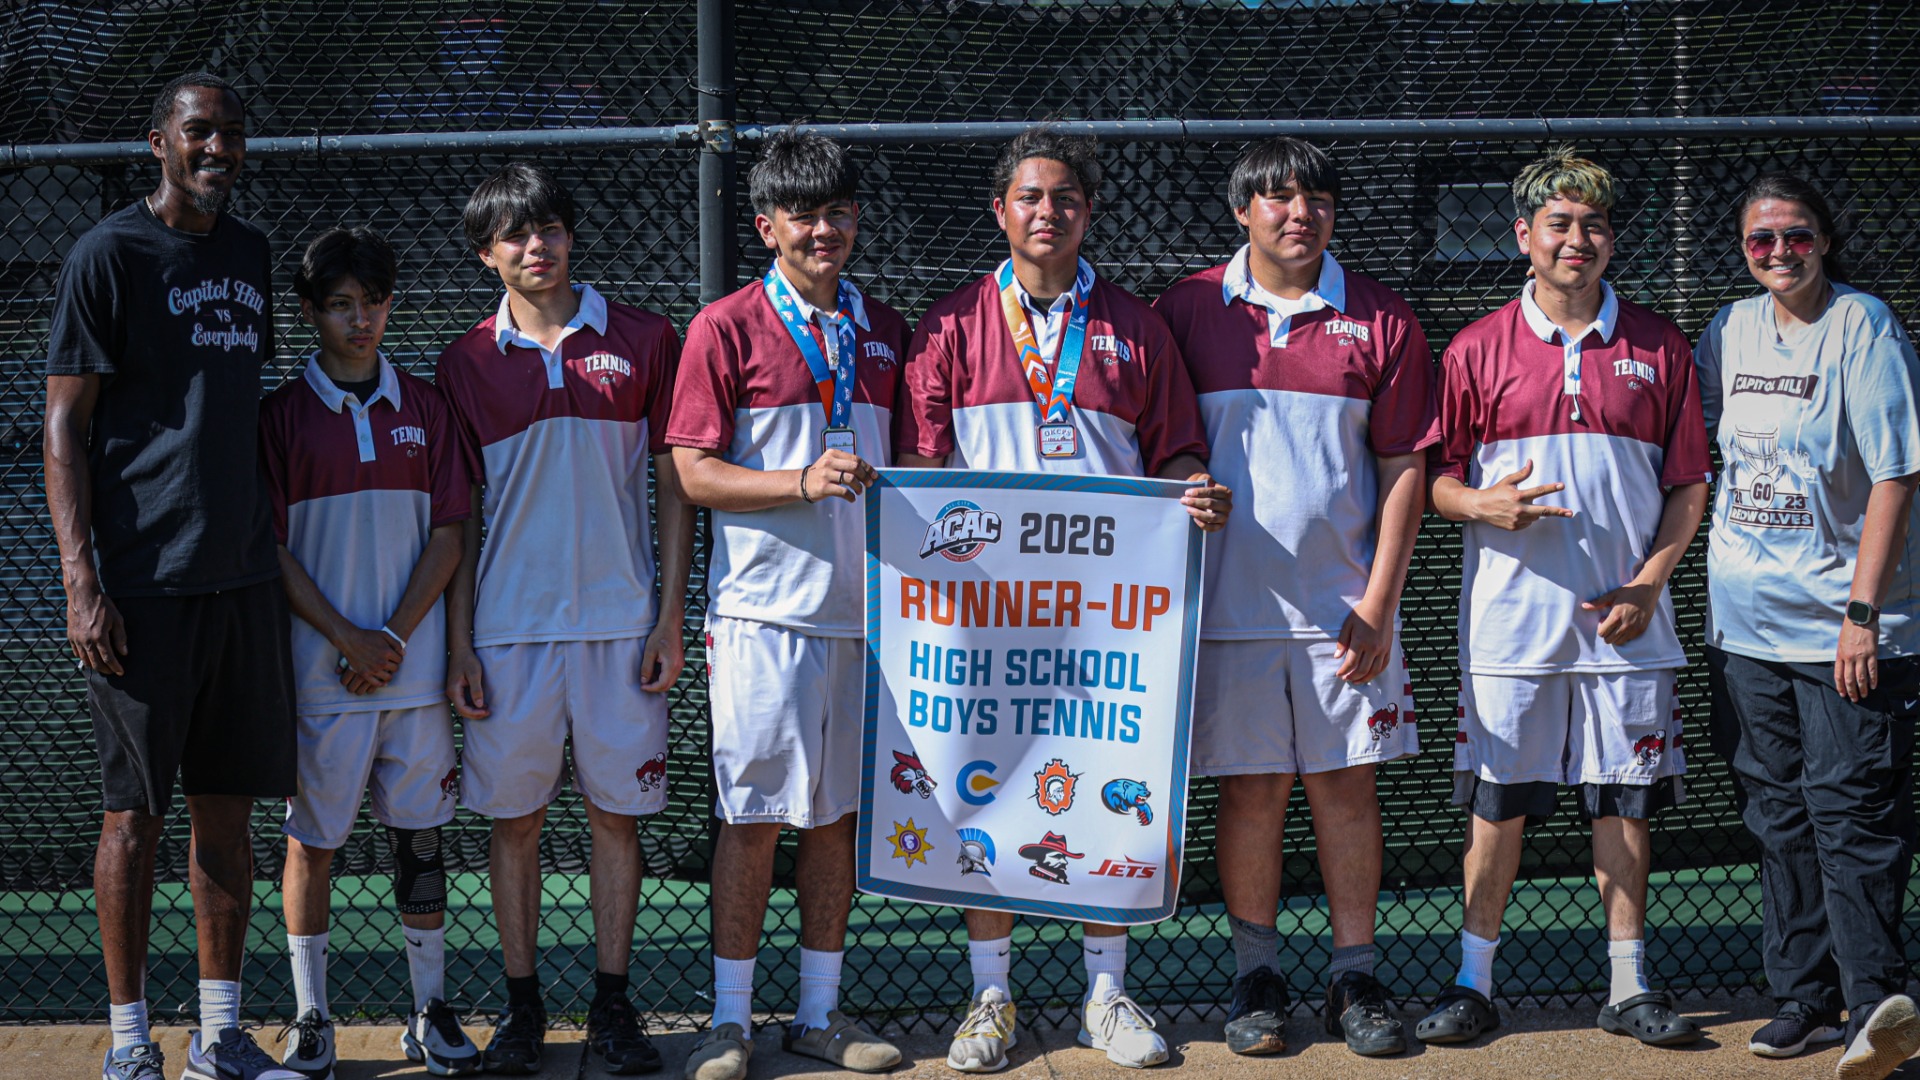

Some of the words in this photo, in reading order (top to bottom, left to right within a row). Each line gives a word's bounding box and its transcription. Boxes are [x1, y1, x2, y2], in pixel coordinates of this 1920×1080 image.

[168, 277, 230, 315] Capitol
[234, 280, 264, 315] Hill
[191, 323, 258, 353] Everybody
[1325, 319, 1369, 342] TENNIS
[585, 354, 631, 377] TENNIS
[1613, 358, 1655, 385] TENNIS
[390, 425, 427, 447] TENNI
[1753, 482, 1772, 501] GO
[1784, 495, 1807, 510] 23
[1731, 507, 1812, 526] REDWOLVES
[919, 510, 1002, 560] ACAC
[1019, 512, 1116, 557] 2026
[900, 576, 1171, 632] RUNNER-UP
[908, 640, 992, 687] HIGH
[1005, 648, 1147, 693] SCHOOL
[908, 689, 998, 736] BOYS
[1010, 698, 1142, 744] TENNIS
[1088, 858, 1158, 879] JETS
